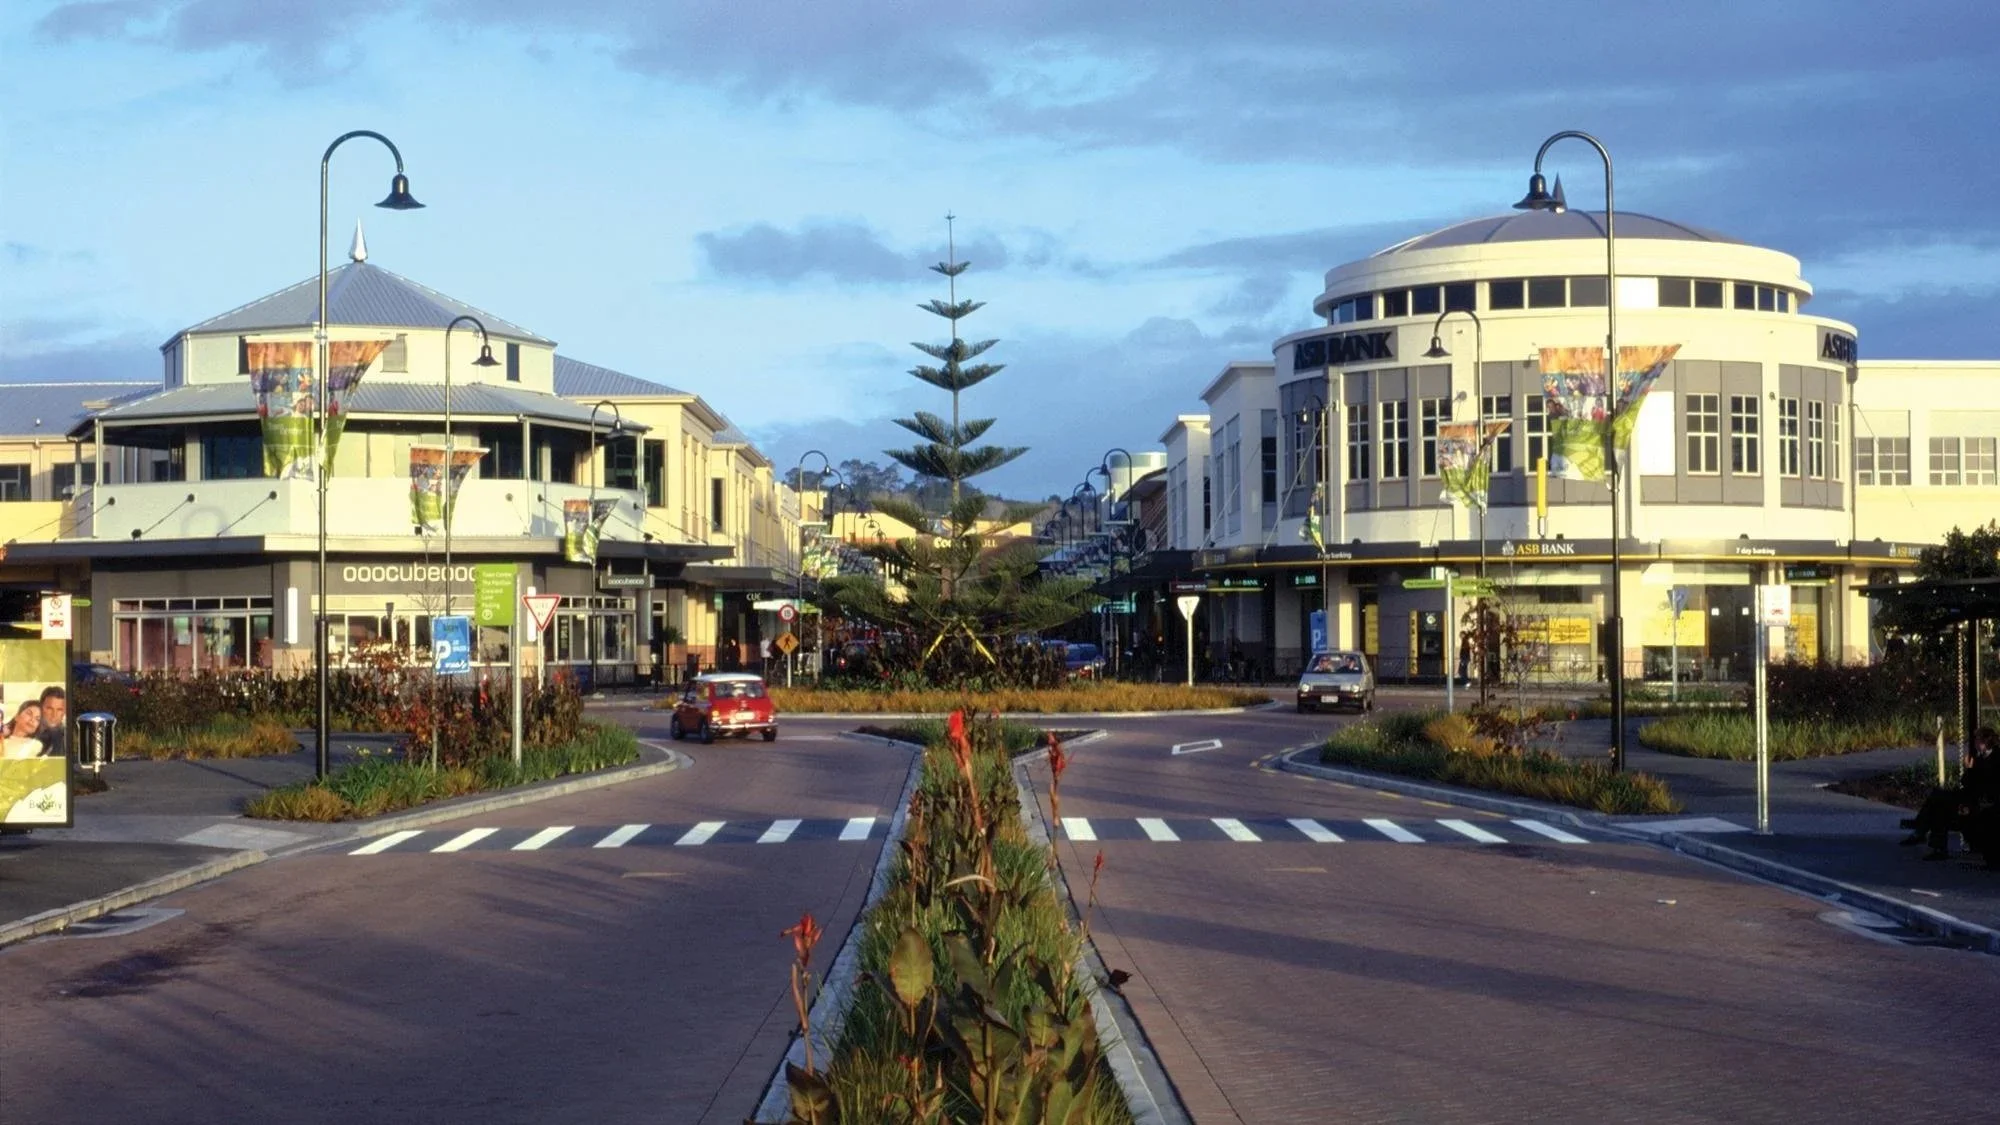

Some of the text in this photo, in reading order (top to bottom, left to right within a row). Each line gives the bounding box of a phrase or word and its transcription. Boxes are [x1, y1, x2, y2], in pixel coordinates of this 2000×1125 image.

[1294, 331, 1393, 370] ASB BANK
[1516, 543, 1575, 555] ASB BANK
[1740, 547, 1751, 556] day
[1752, 547, 1775, 556] banking
